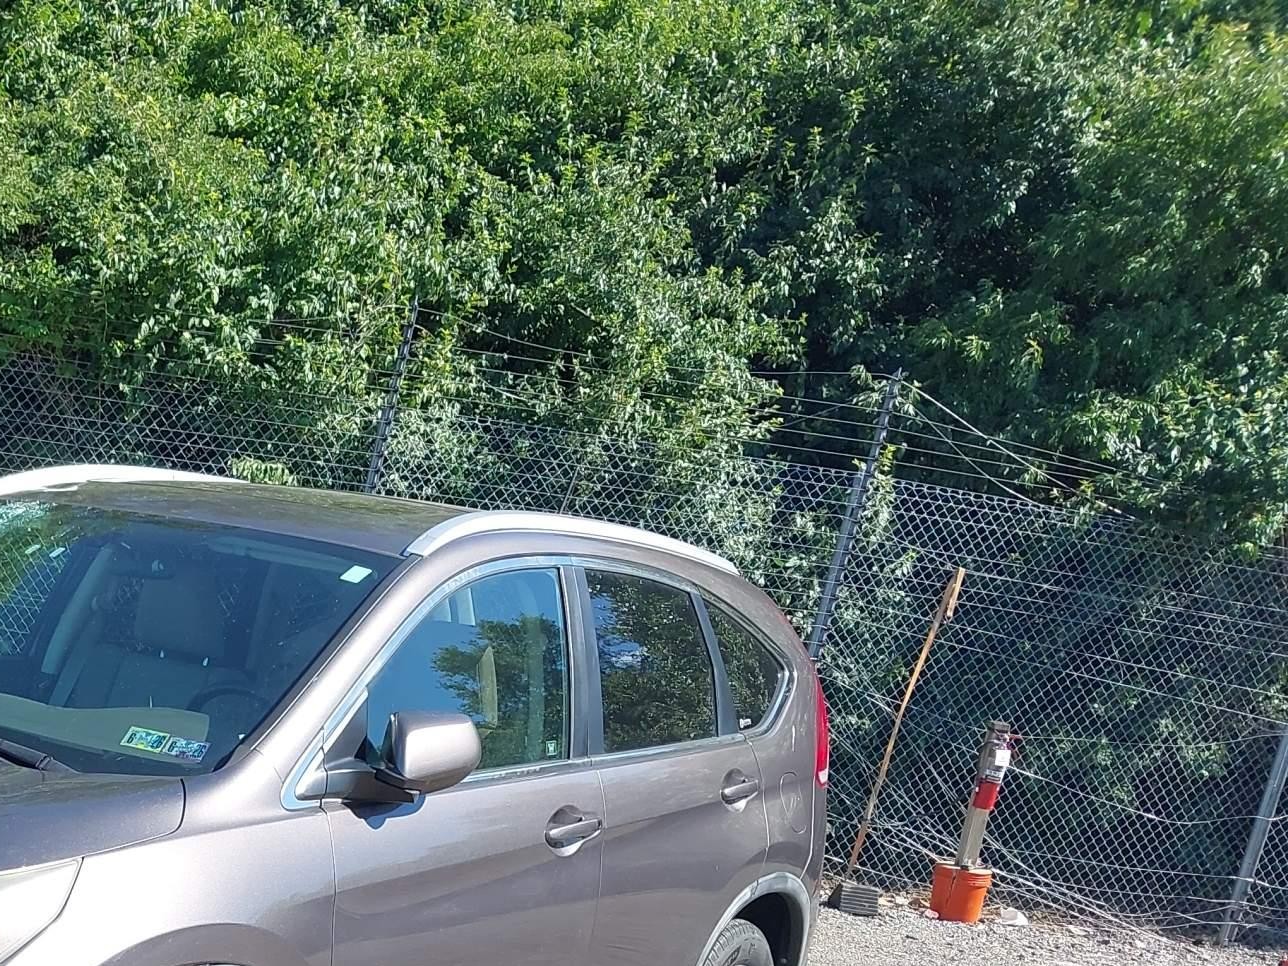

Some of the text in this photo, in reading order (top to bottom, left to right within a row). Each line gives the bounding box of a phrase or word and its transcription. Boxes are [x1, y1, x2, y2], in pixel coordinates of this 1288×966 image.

[127, 733, 165, 749] 6 26
[168, 741, 177, 752] 6
